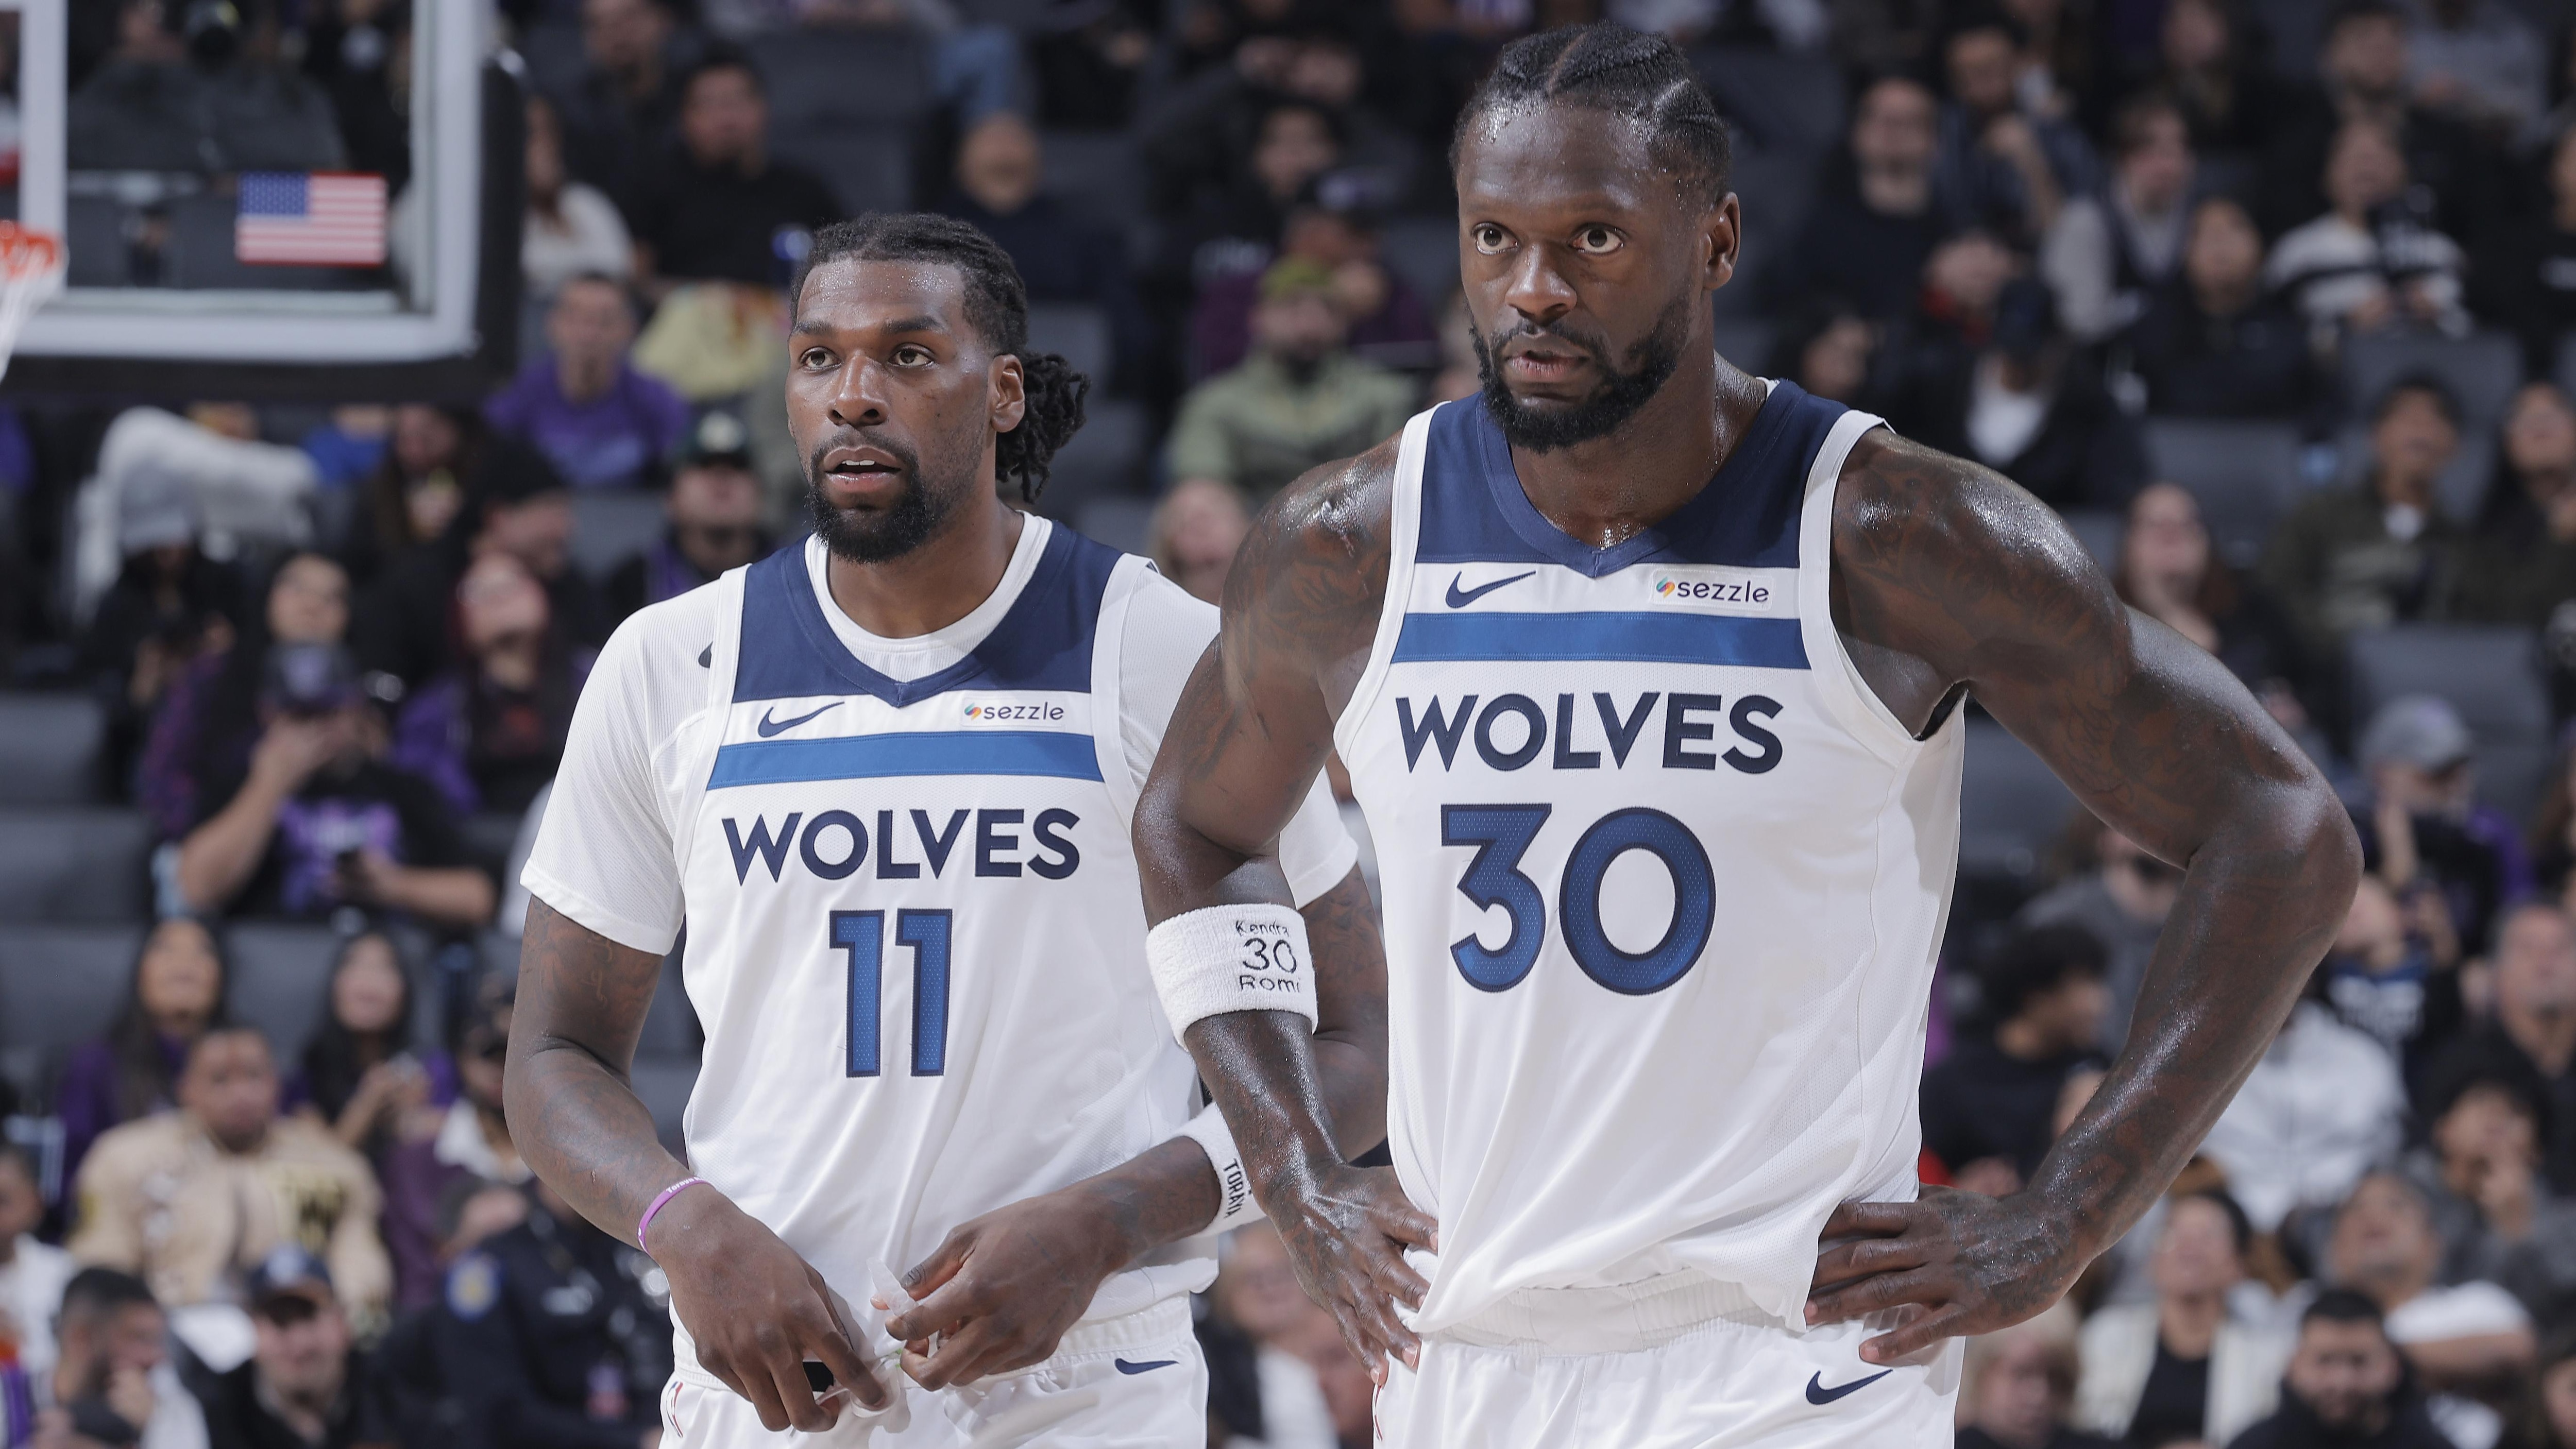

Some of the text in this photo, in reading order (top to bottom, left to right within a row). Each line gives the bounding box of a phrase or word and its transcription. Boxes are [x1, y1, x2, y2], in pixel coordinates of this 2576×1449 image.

[1677, 581, 1769, 603] sezzle
[984, 702, 1064, 720] sezzle
[1396, 692, 1784, 774] WOLVES
[722, 808, 1080, 886] WOLVES
[1440, 803, 1716, 996] 30
[1242, 937, 1297, 974] 30
[829, 908, 953, 1078] 11
[1223, 1158, 1245, 1219] TORAYA
